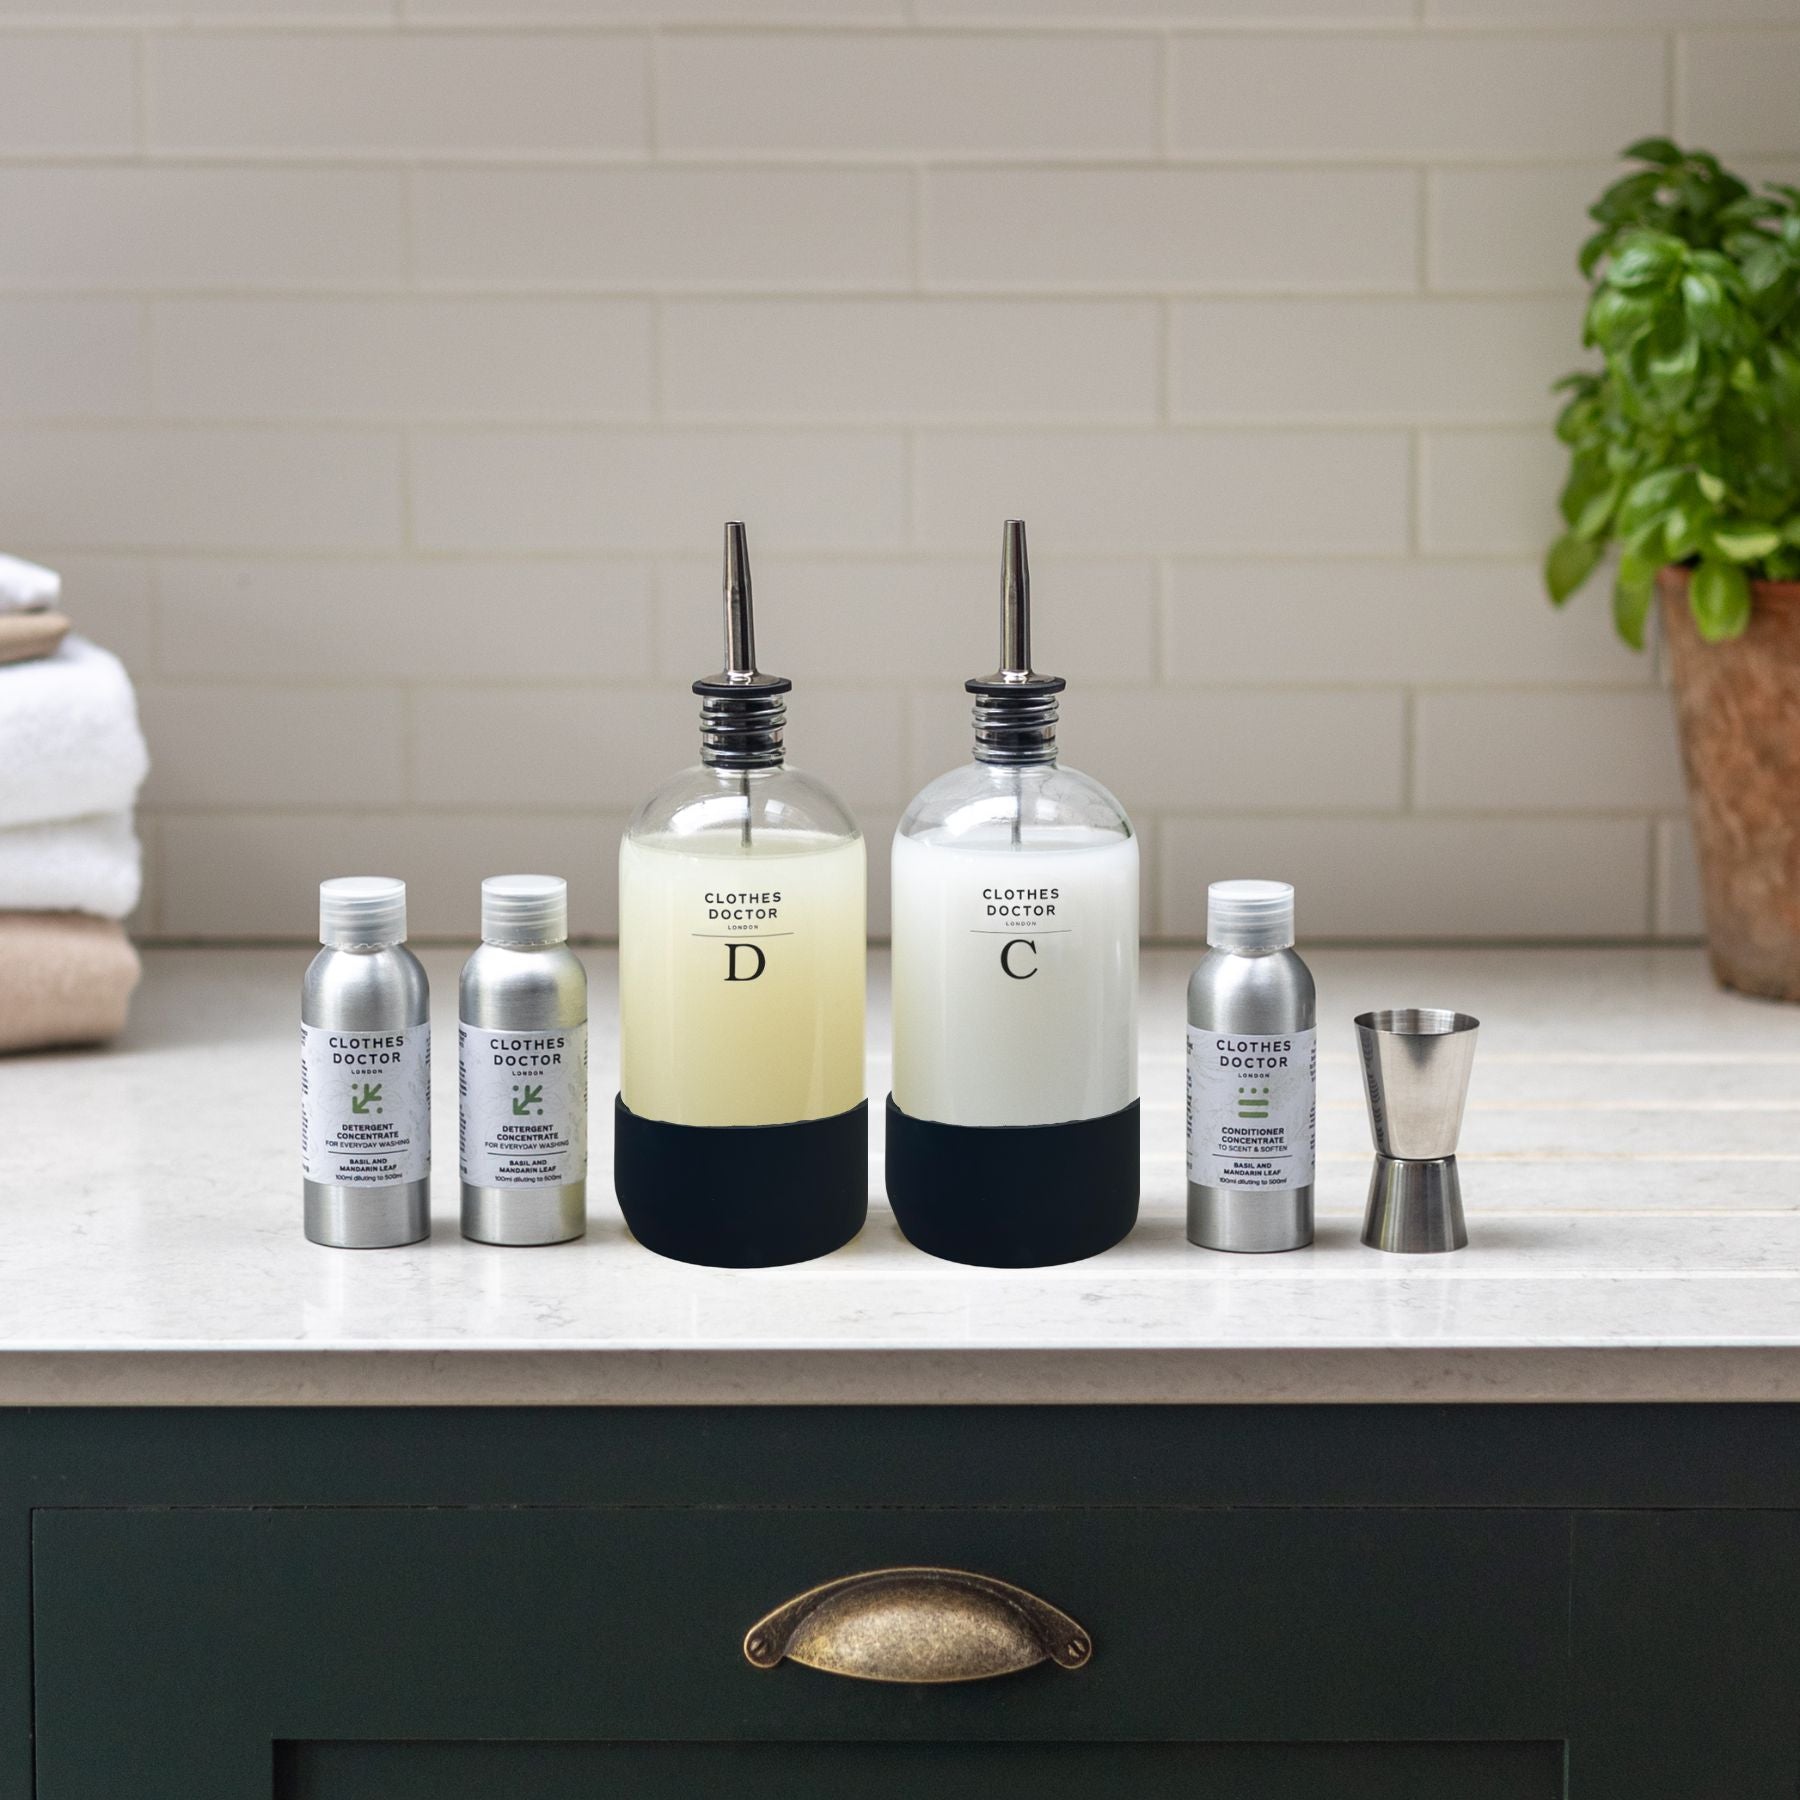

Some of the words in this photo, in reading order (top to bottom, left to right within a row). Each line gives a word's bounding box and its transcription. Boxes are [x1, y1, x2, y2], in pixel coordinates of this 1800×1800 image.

[704, 892, 782, 904] CLOTHES
[982, 888, 1060, 900] CLOTHES
[708, 907, 778, 921] DOCTOR
[987, 904, 1056, 917] DOCTOR
[724, 943, 766, 981] D
[1000, 939, 1038, 980] C
[329, 1036, 404, 1049] CLOTHES
[490, 1037, 565, 1050] CLOTHES
[1216, 1039, 1291, 1052] CLOTHES
[333, 1052, 401, 1065] DOCTOR
[494, 1053, 561, 1066] DOCTOR
[1220, 1055, 1288, 1068] DOCTOR
[342, 1123, 394, 1131] DETERGENT
[503, 1125, 554, 1133] DETERGENT
[1222, 1127, 1285, 1136] CONDITIONER
[337, 1131, 399, 1140] CONCENTRATE
[497, 1133, 559, 1141] CONCENTRATE
[1222, 1136, 1284, 1144] CONCENTRATE
[326, 1139, 338, 1147] FOR
[340, 1140, 377, 1149] EVERYDAY
[379, 1138, 410, 1147] WASHING
[485, 1141, 498, 1149] FOR
[500, 1142, 537, 1150] EVERYDAY
[539, 1140, 569, 1149] WASHING
[1260, 1144, 1288, 1152] SOFTEN
